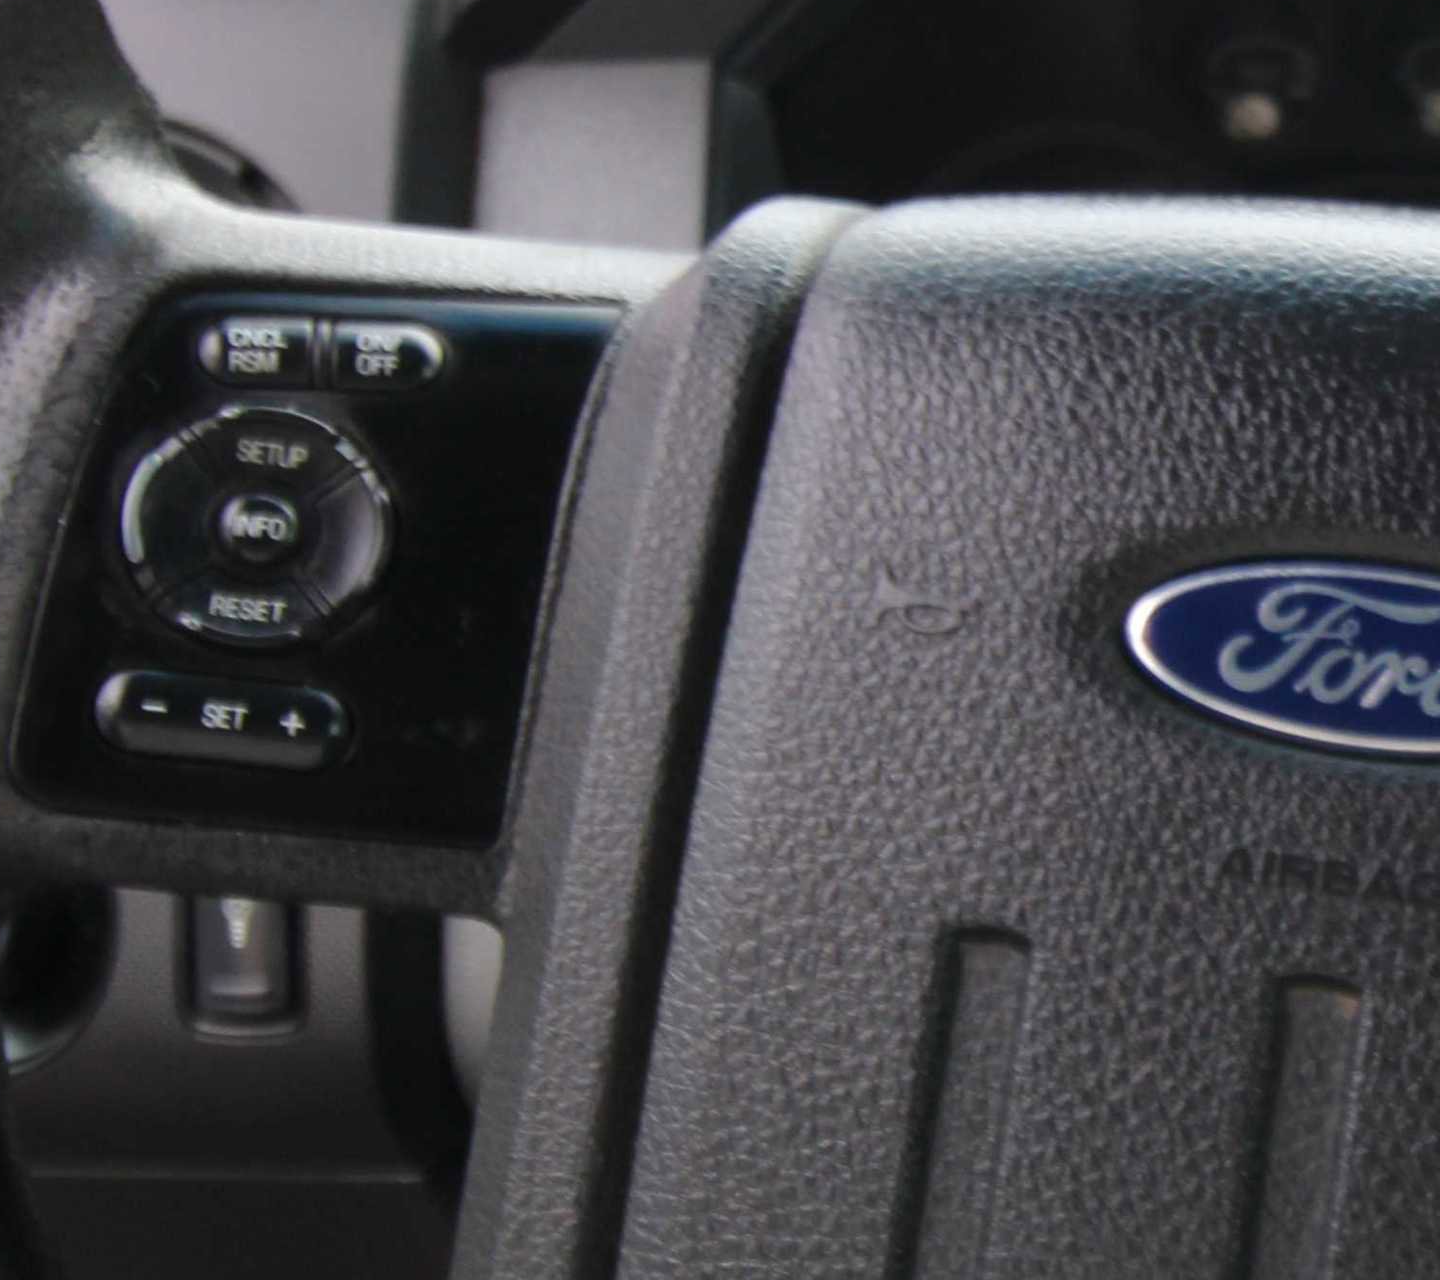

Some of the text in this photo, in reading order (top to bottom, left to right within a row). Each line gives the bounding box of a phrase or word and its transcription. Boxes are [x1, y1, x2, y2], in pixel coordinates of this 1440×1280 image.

[227, 350, 281, 373] RSM
[356, 353, 400, 377] OFF
[236, 439, 309, 470] SETUP
[232, 517, 287, 541] INFO
[208, 592, 289, 622] RESET
[200, 703, 250, 731] SET
